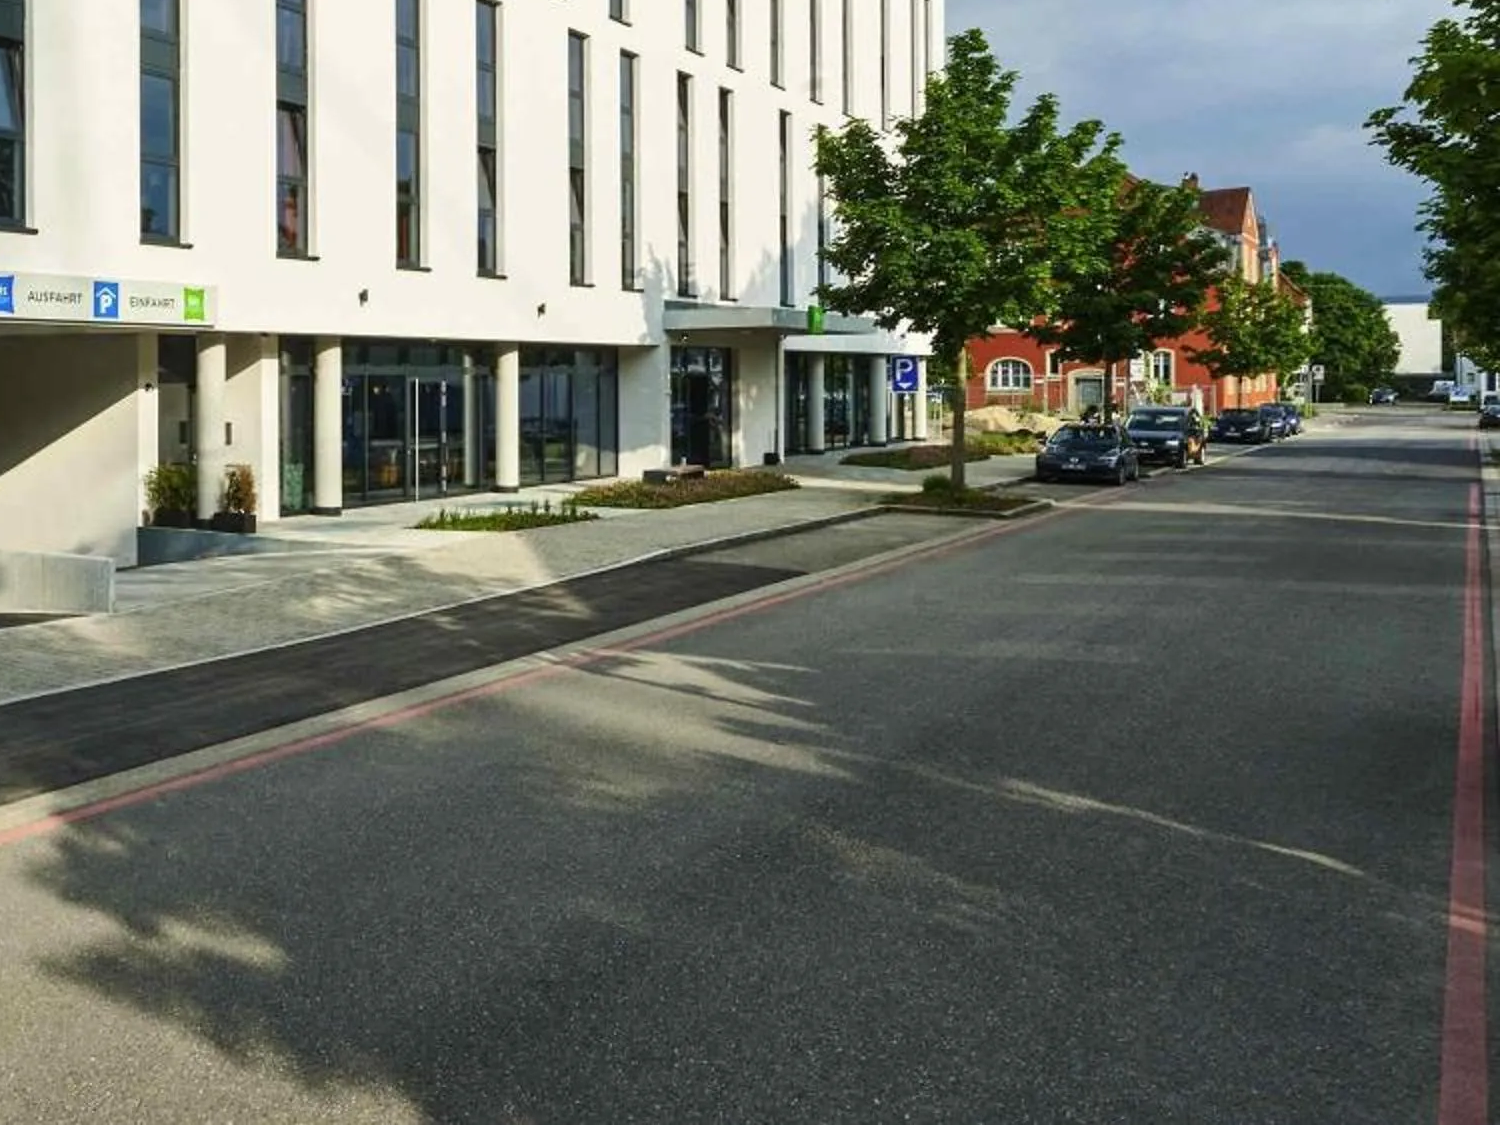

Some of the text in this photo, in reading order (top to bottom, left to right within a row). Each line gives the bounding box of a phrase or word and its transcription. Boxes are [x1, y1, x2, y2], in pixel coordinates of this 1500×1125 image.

[27, 290, 83, 305] AUSFAHRT
[129, 296, 176, 309] EINFAHRT
[895, 358, 913, 382] P
